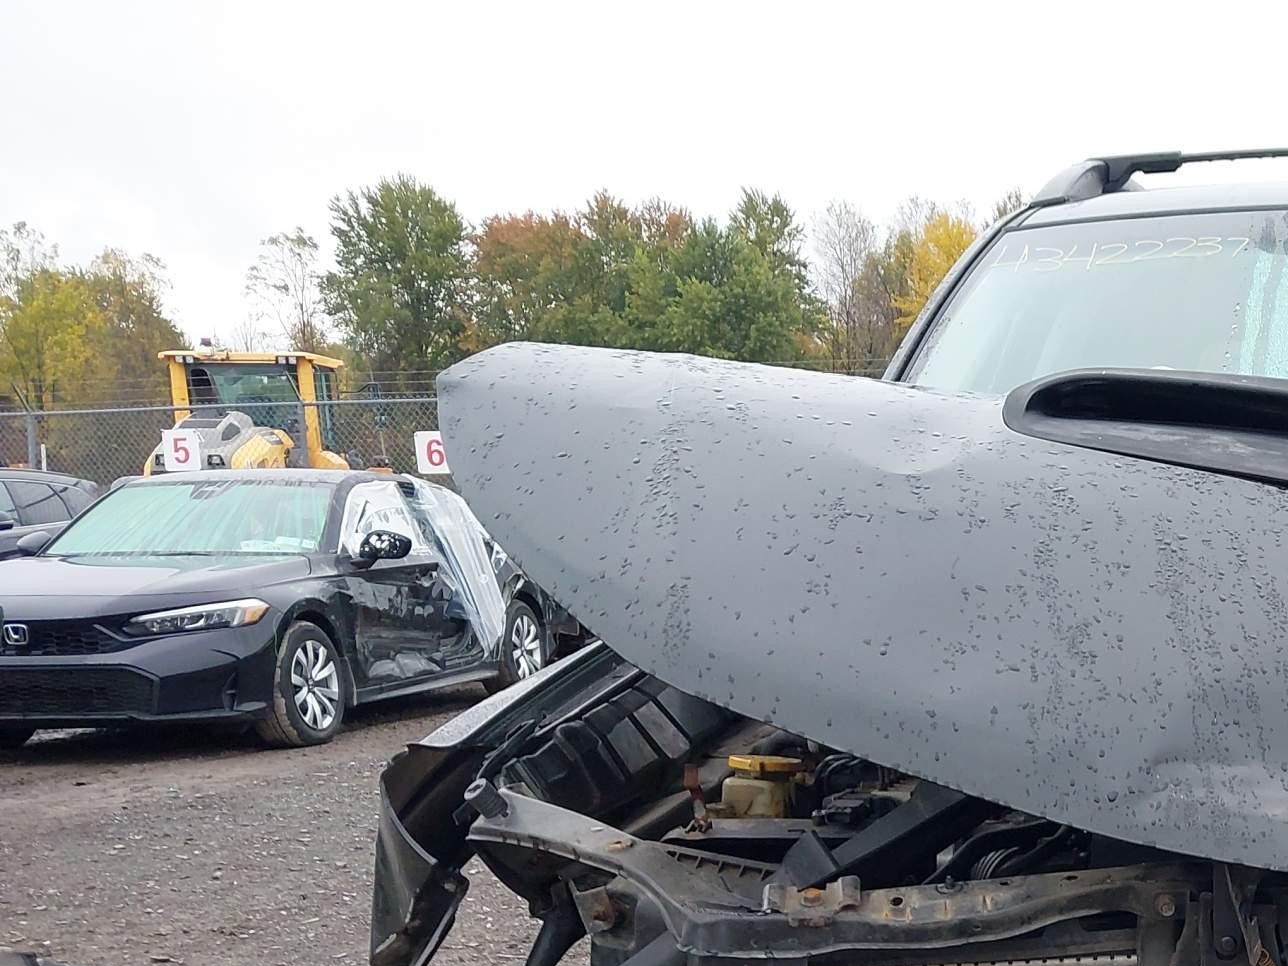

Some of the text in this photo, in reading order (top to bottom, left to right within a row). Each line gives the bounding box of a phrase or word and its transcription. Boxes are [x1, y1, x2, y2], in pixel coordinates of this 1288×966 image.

[990, 236, 1250, 273] 43422237
[172, 437, 190, 464] 5
[426, 439, 445, 467] 6
